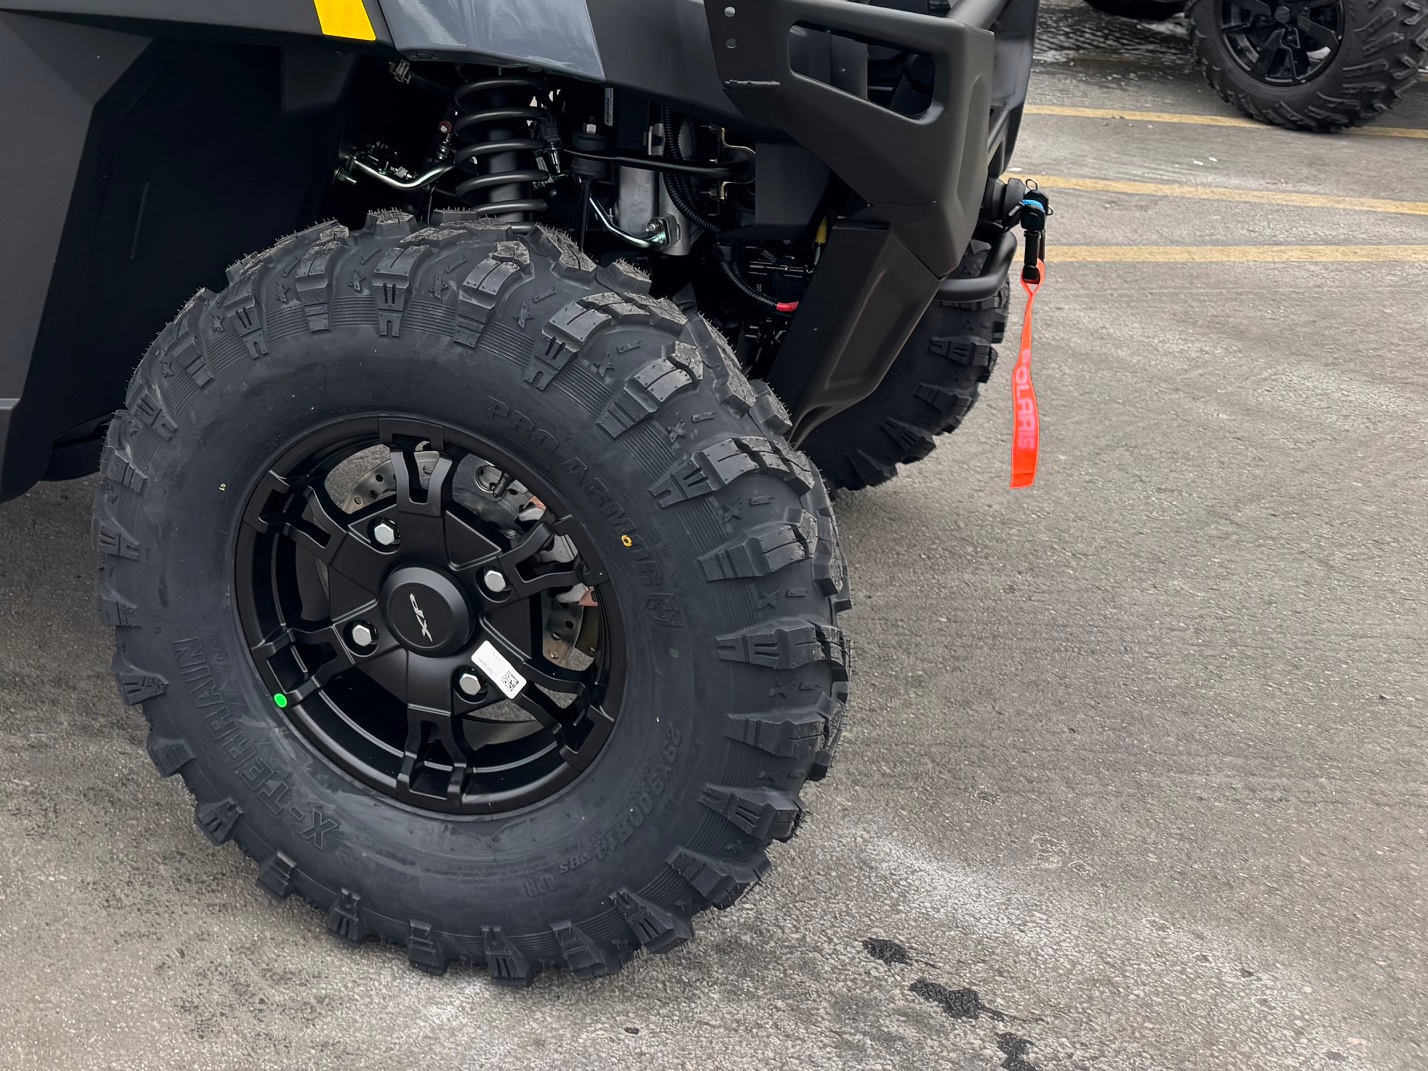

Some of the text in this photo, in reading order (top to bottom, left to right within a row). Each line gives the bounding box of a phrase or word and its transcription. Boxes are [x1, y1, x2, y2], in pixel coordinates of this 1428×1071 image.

[485, 395, 664, 587] PRO ARMOR
[1015, 349, 1036, 450] POLARIS
[171, 634, 340, 851] X-TERRAIN
